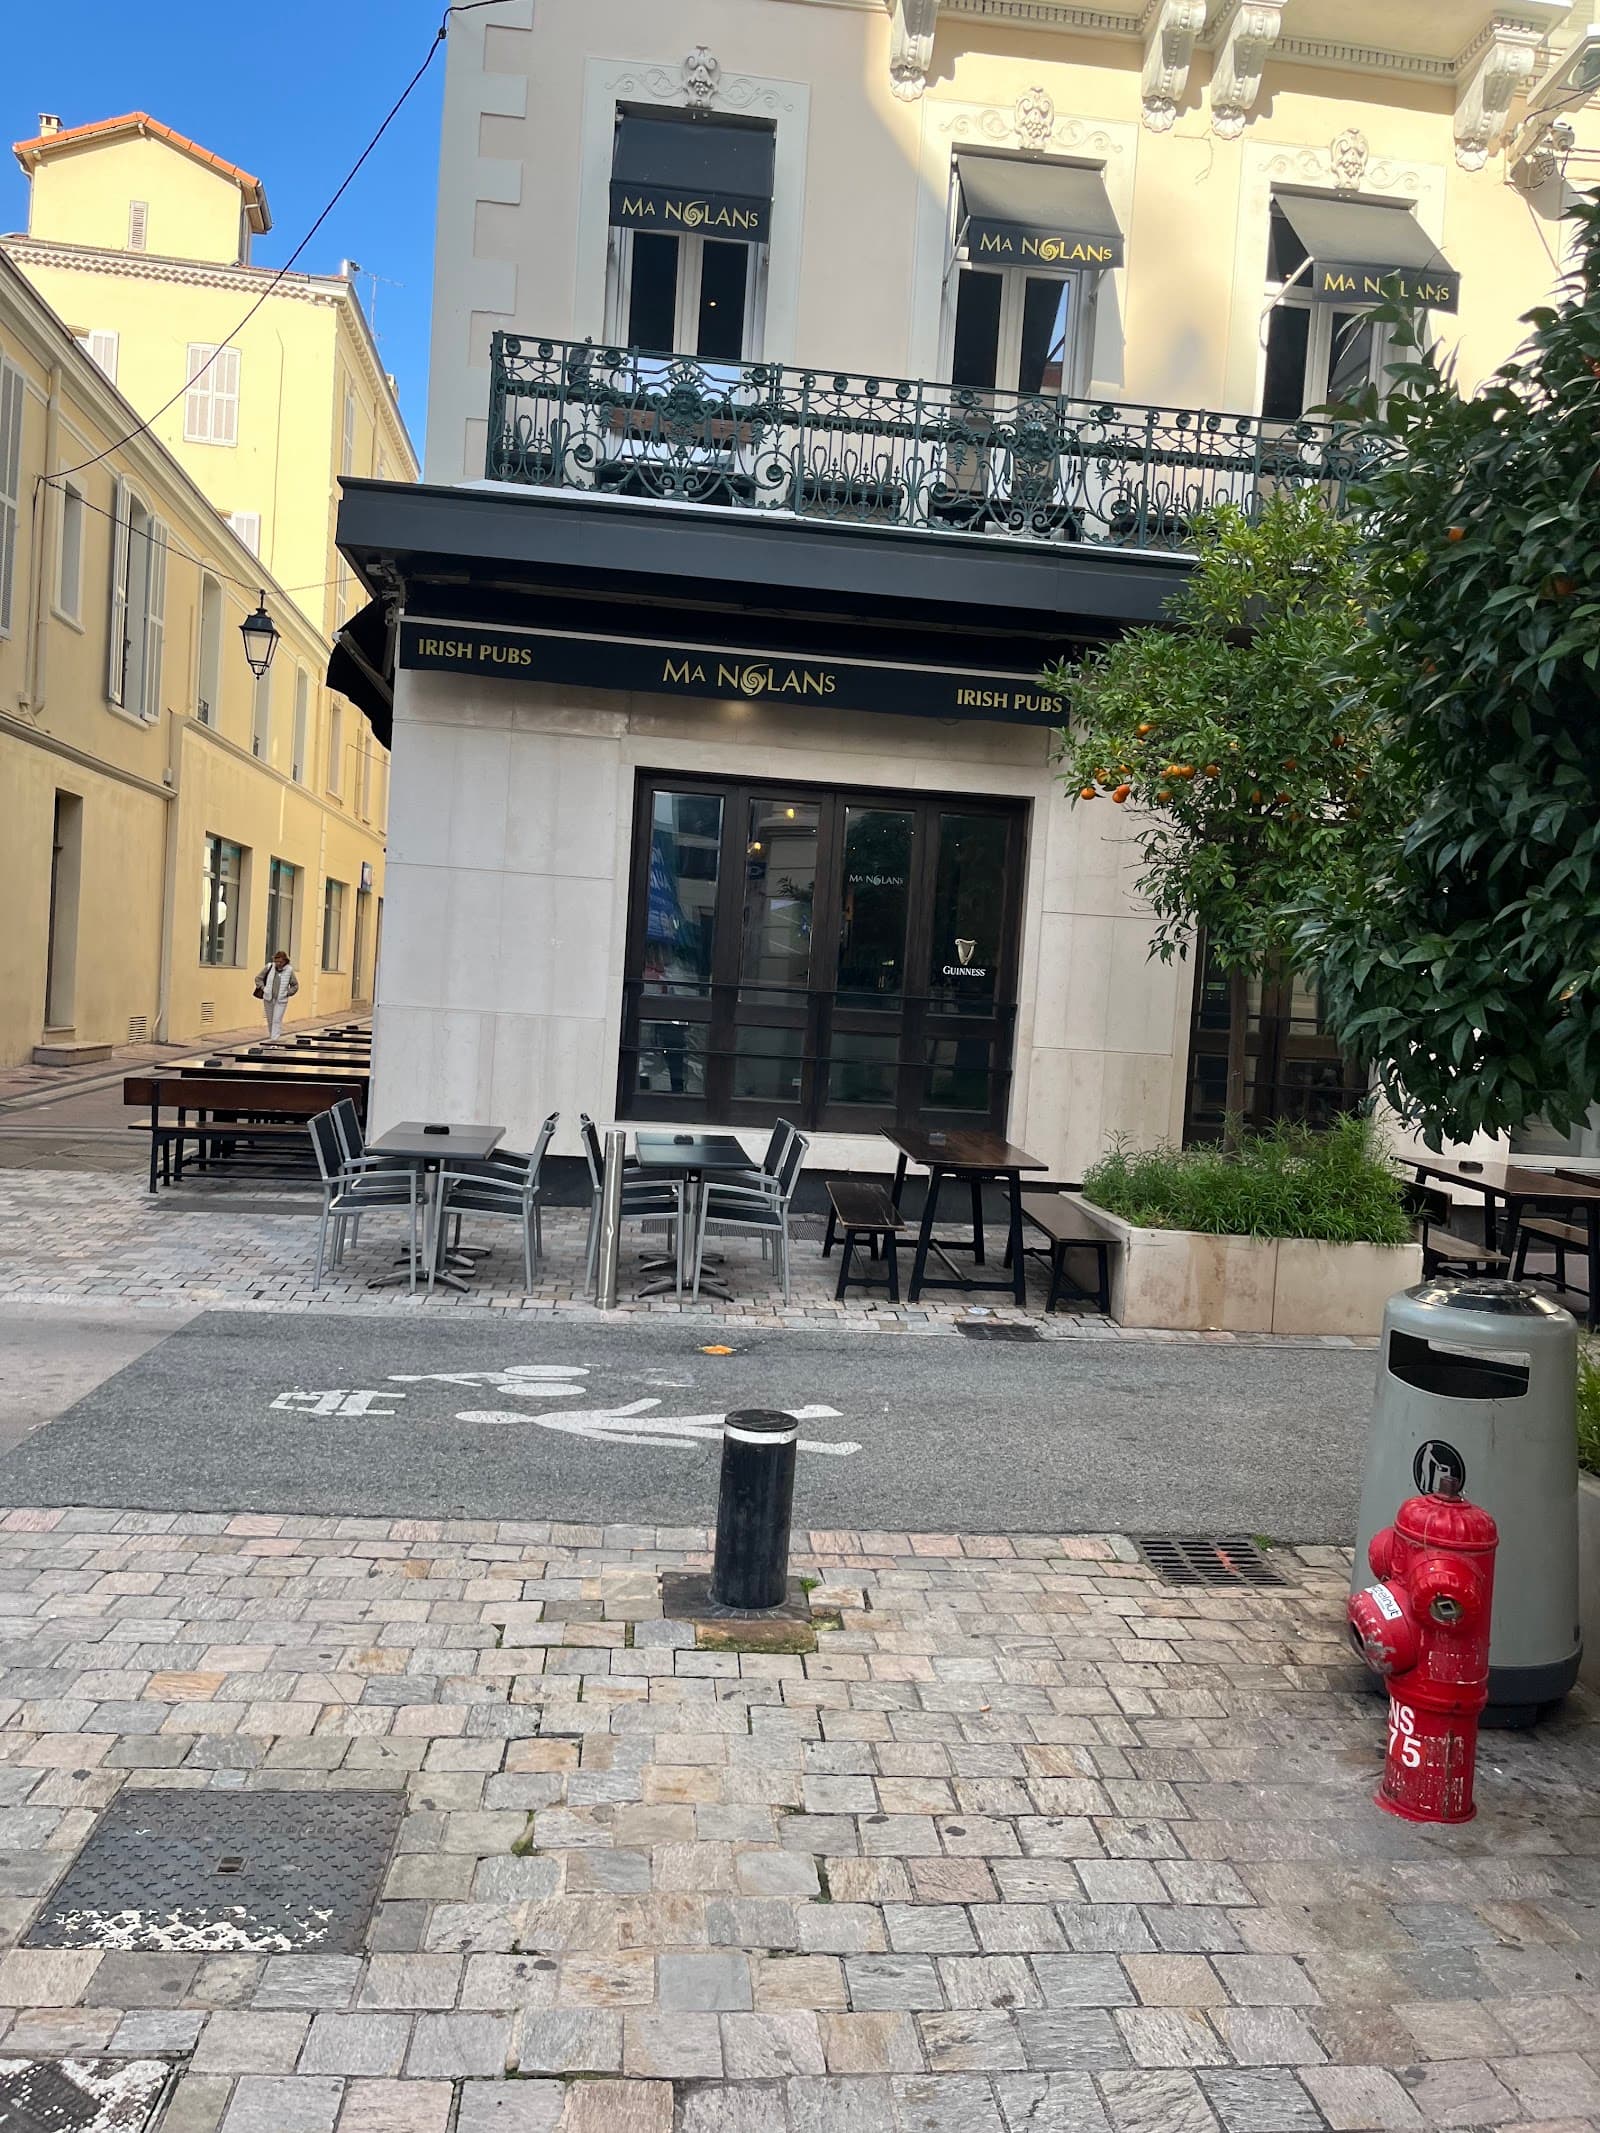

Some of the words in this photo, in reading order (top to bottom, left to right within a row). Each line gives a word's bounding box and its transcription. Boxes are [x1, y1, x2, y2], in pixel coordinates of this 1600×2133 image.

[1364, 275, 1449, 303] NLANS
[418, 638, 473, 660] IRISH
[479, 644, 532, 665] PUBS
[956, 688, 1009, 709] IRISH
[1014, 693, 1063, 713] PUBS
[942, 965, 986, 977] GUINNESS
